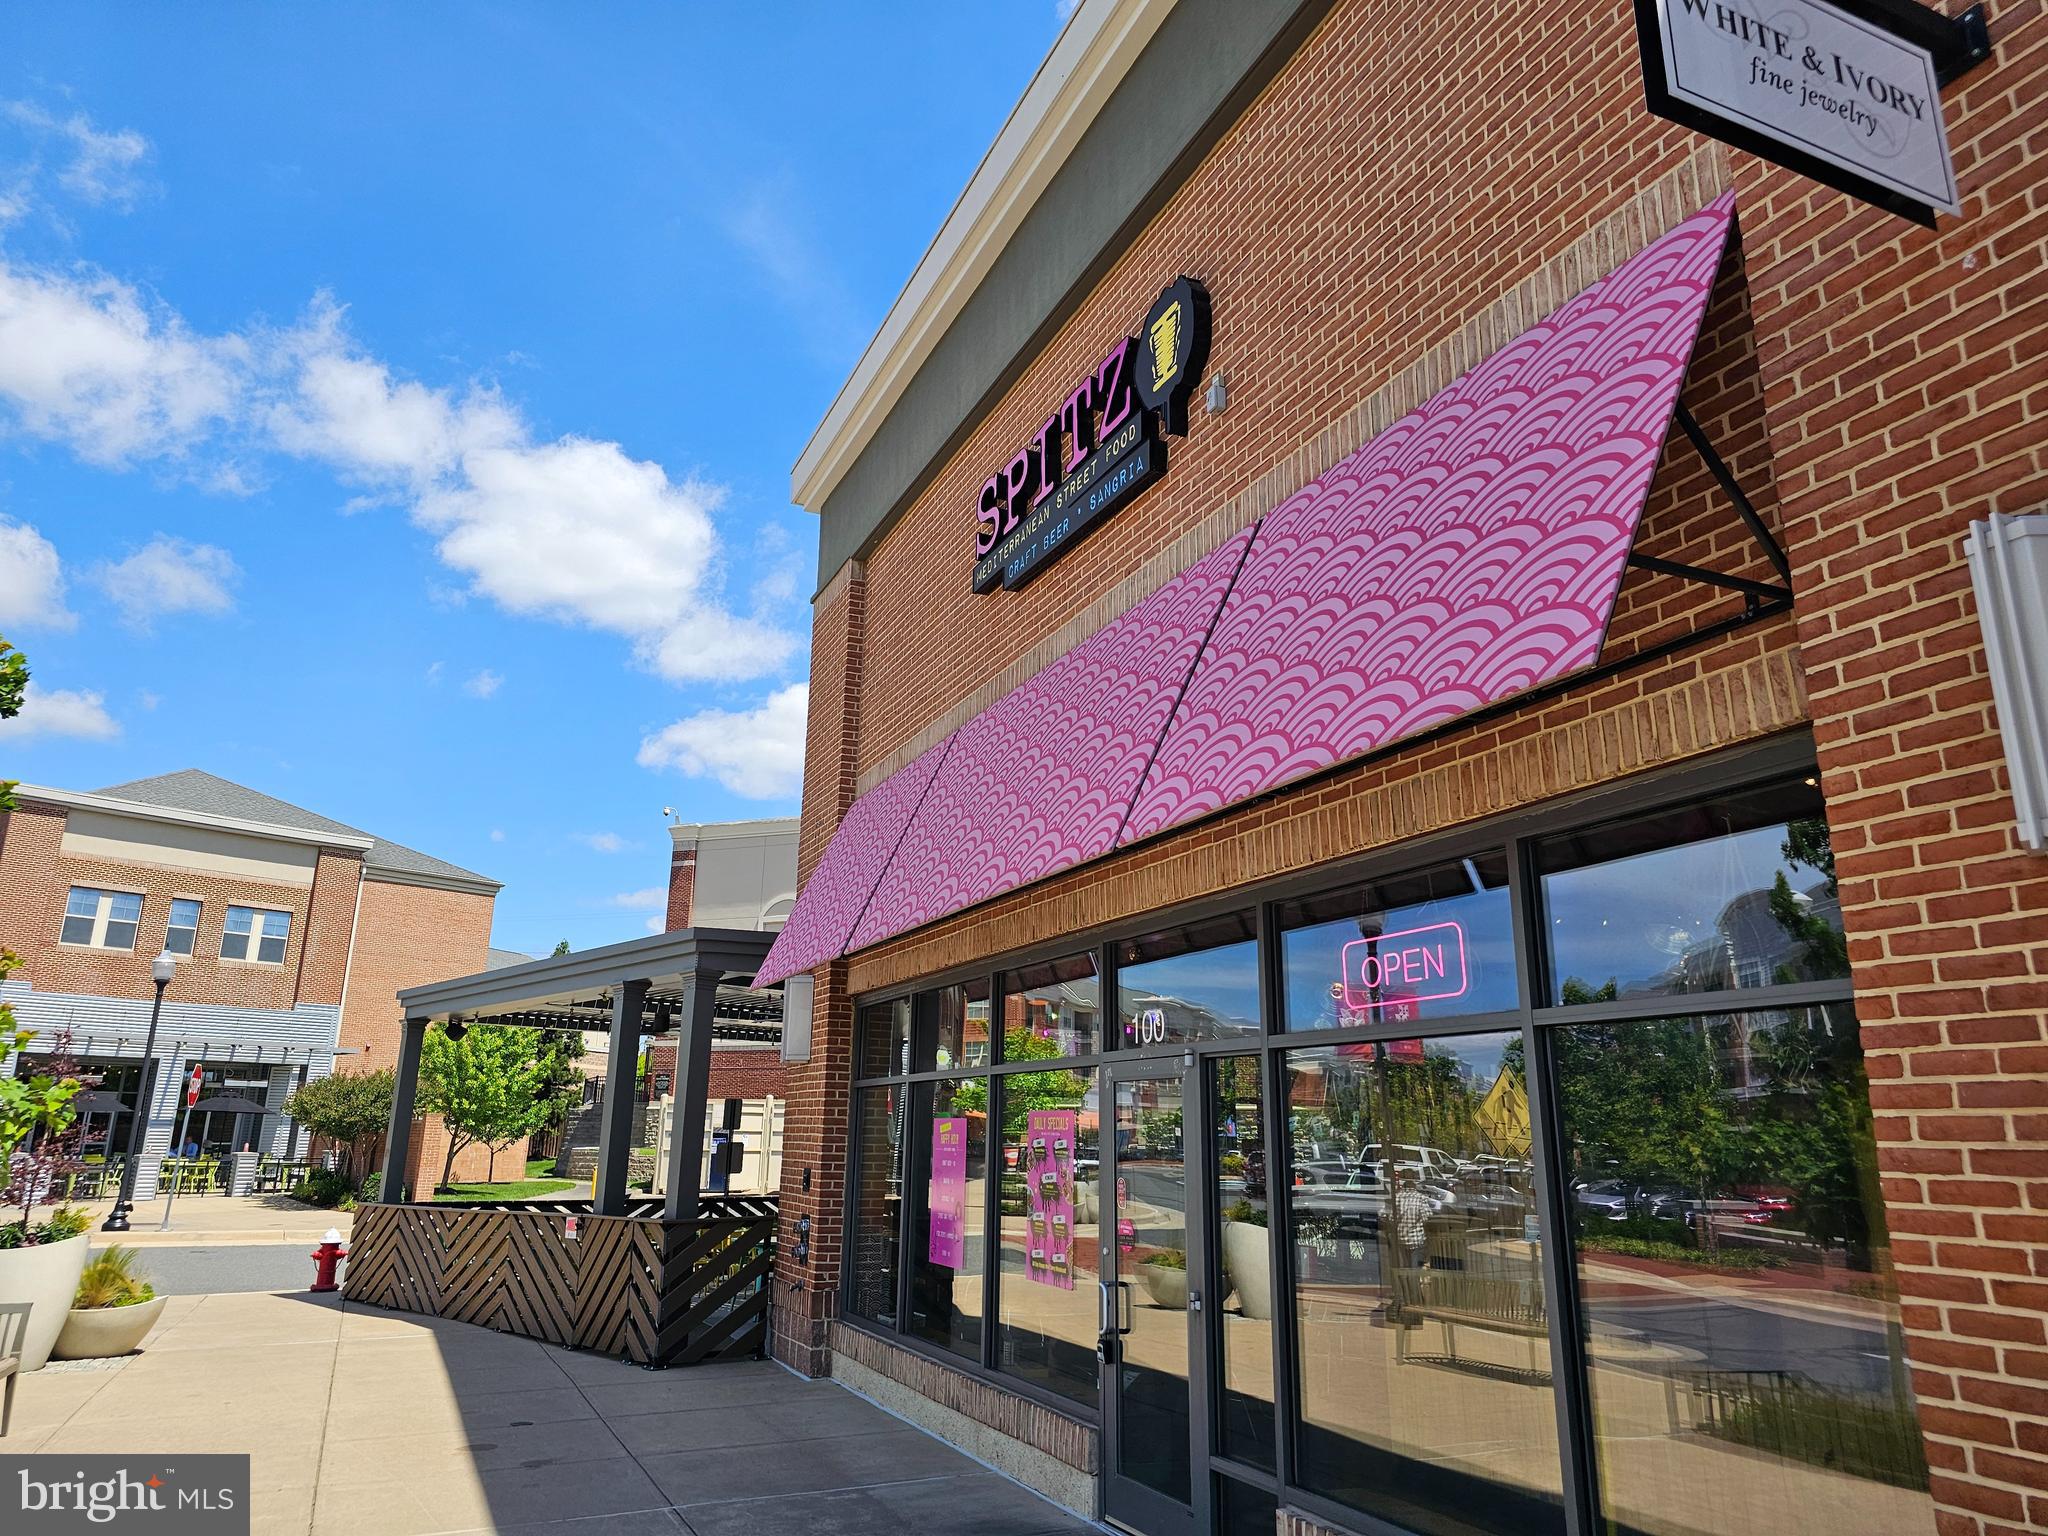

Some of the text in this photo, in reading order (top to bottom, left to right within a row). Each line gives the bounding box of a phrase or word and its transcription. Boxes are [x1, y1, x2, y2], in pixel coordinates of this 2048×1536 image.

[1749, 56, 1878, 137] fine jewelry
[1801, 45, 1825, 75] &
[1832, 54, 1927, 121] IVORY
[976, 335, 1132, 559] SPITZ
[976, 423, 1137, 584] MEDITERRANEAN STREET FOOD
[1007, 457, 1144, 578] CRAFT BEER SANGRIA
[1361, 943, 1445, 988] OPEN
[1131, 1009, 1165, 1044] 100
